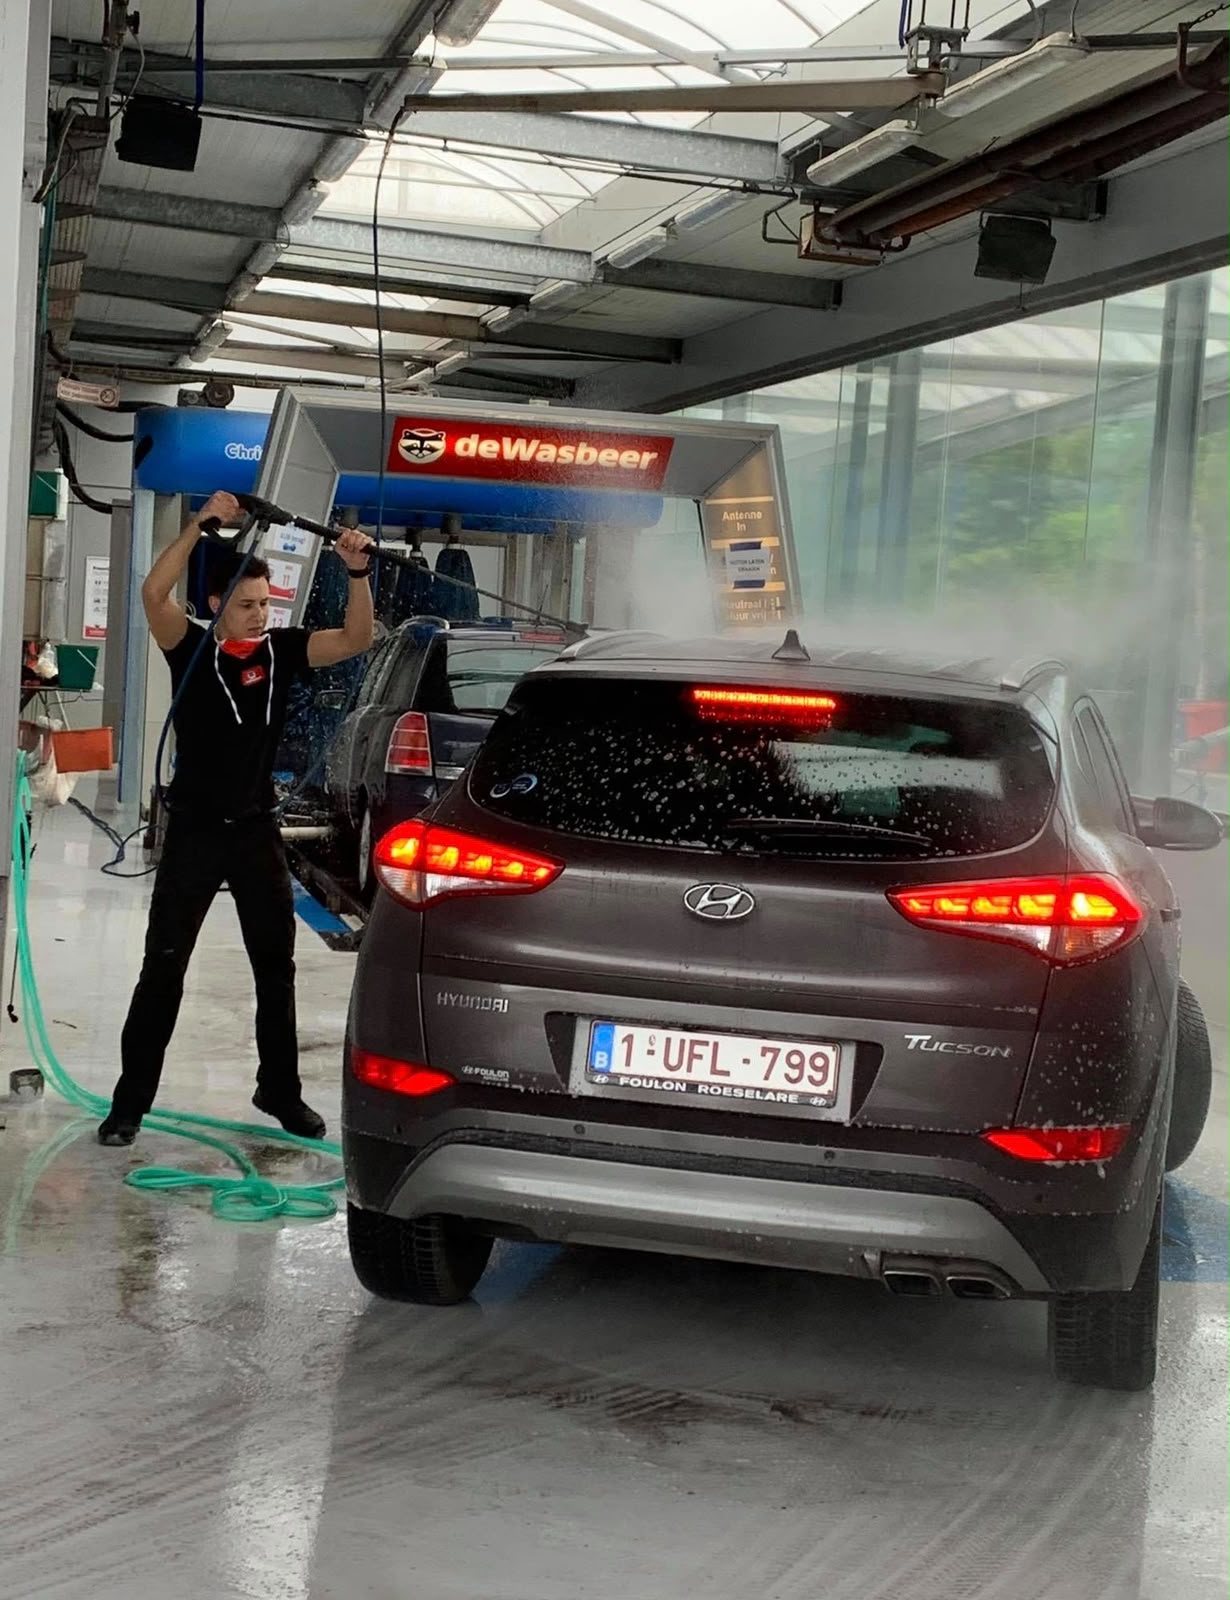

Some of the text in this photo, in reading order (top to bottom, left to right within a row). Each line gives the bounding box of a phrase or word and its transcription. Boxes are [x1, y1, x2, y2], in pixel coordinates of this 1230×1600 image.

[224, 442, 263, 461] Chri
[454, 434, 659, 470] deWasbeer
[722, 511, 763, 521] Antenne
[437, 992, 508, 1013] HYUNDAI
[594, 1051, 609, 1069] B
[619, 1076, 799, 1104] FOULON ROESELARE
